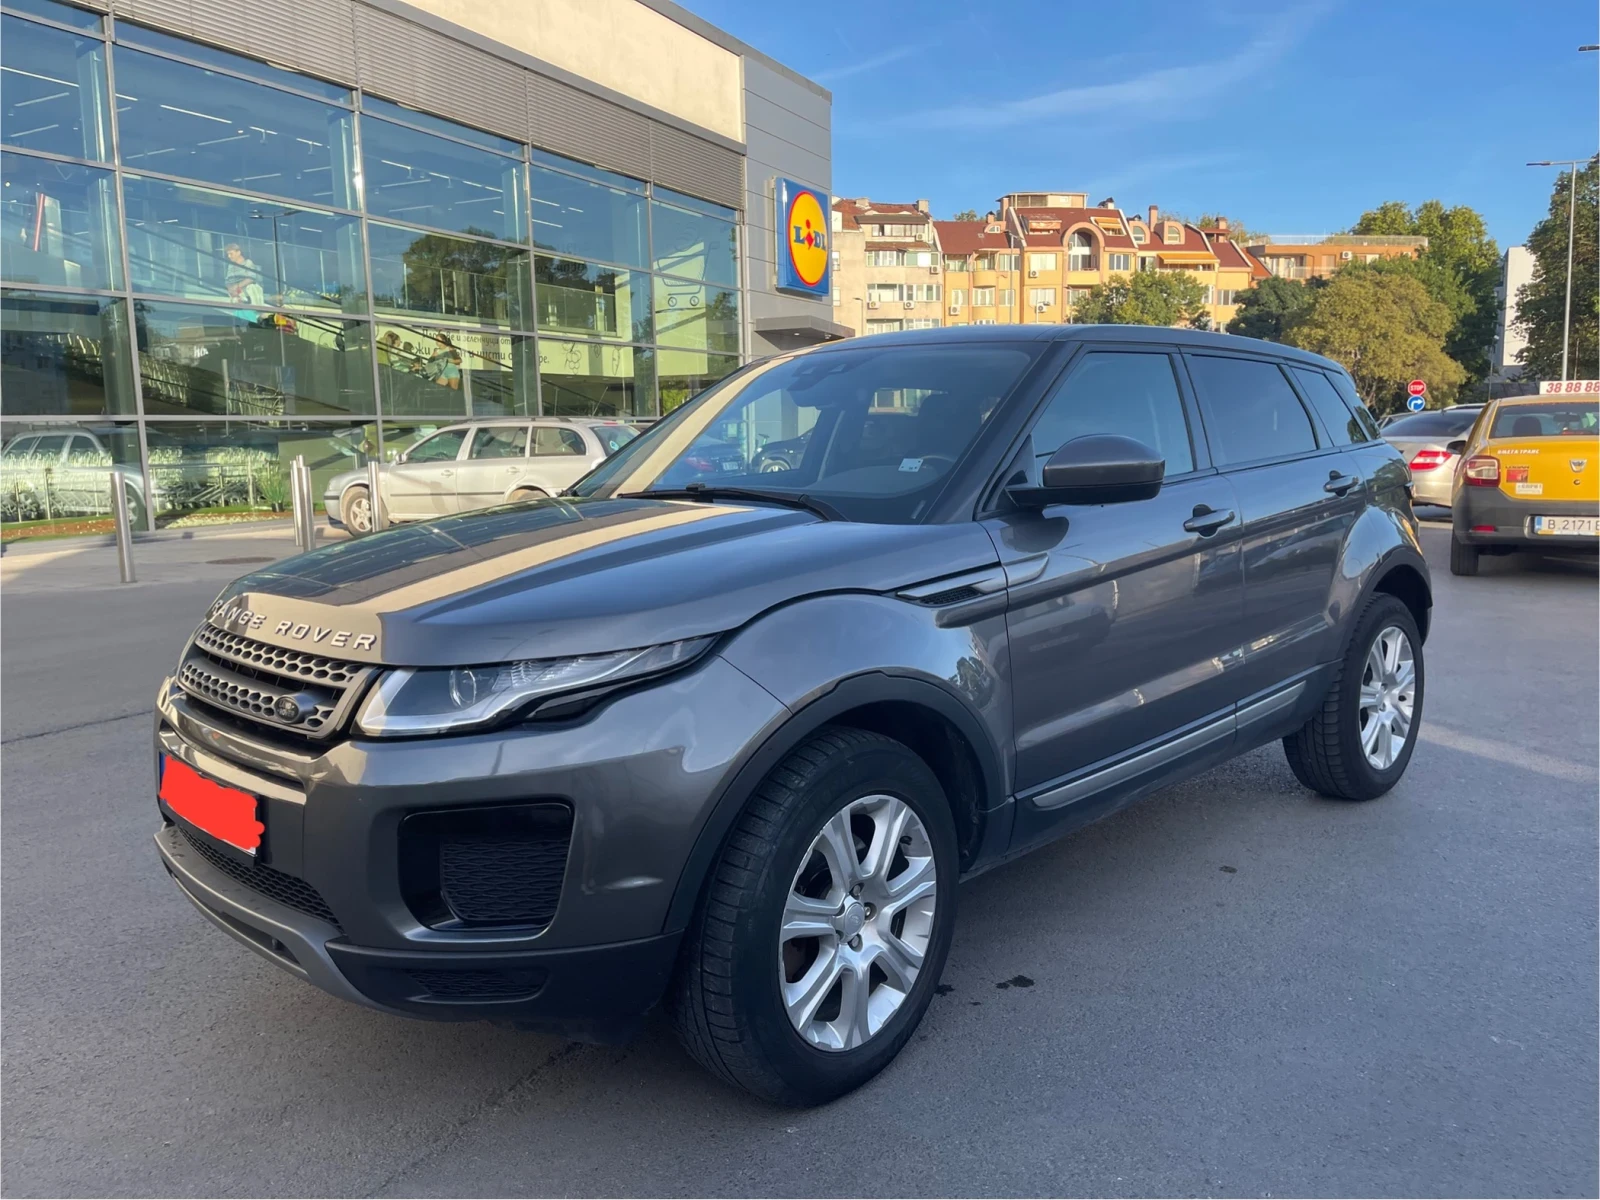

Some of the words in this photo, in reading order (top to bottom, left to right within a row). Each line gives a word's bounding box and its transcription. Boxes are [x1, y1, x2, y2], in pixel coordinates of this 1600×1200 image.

[1546, 382, 1562, 393] 38
[1565, 382, 1582, 393] 88
[212, 599, 266, 630] RANGE
[275, 620, 377, 650] ROVER
